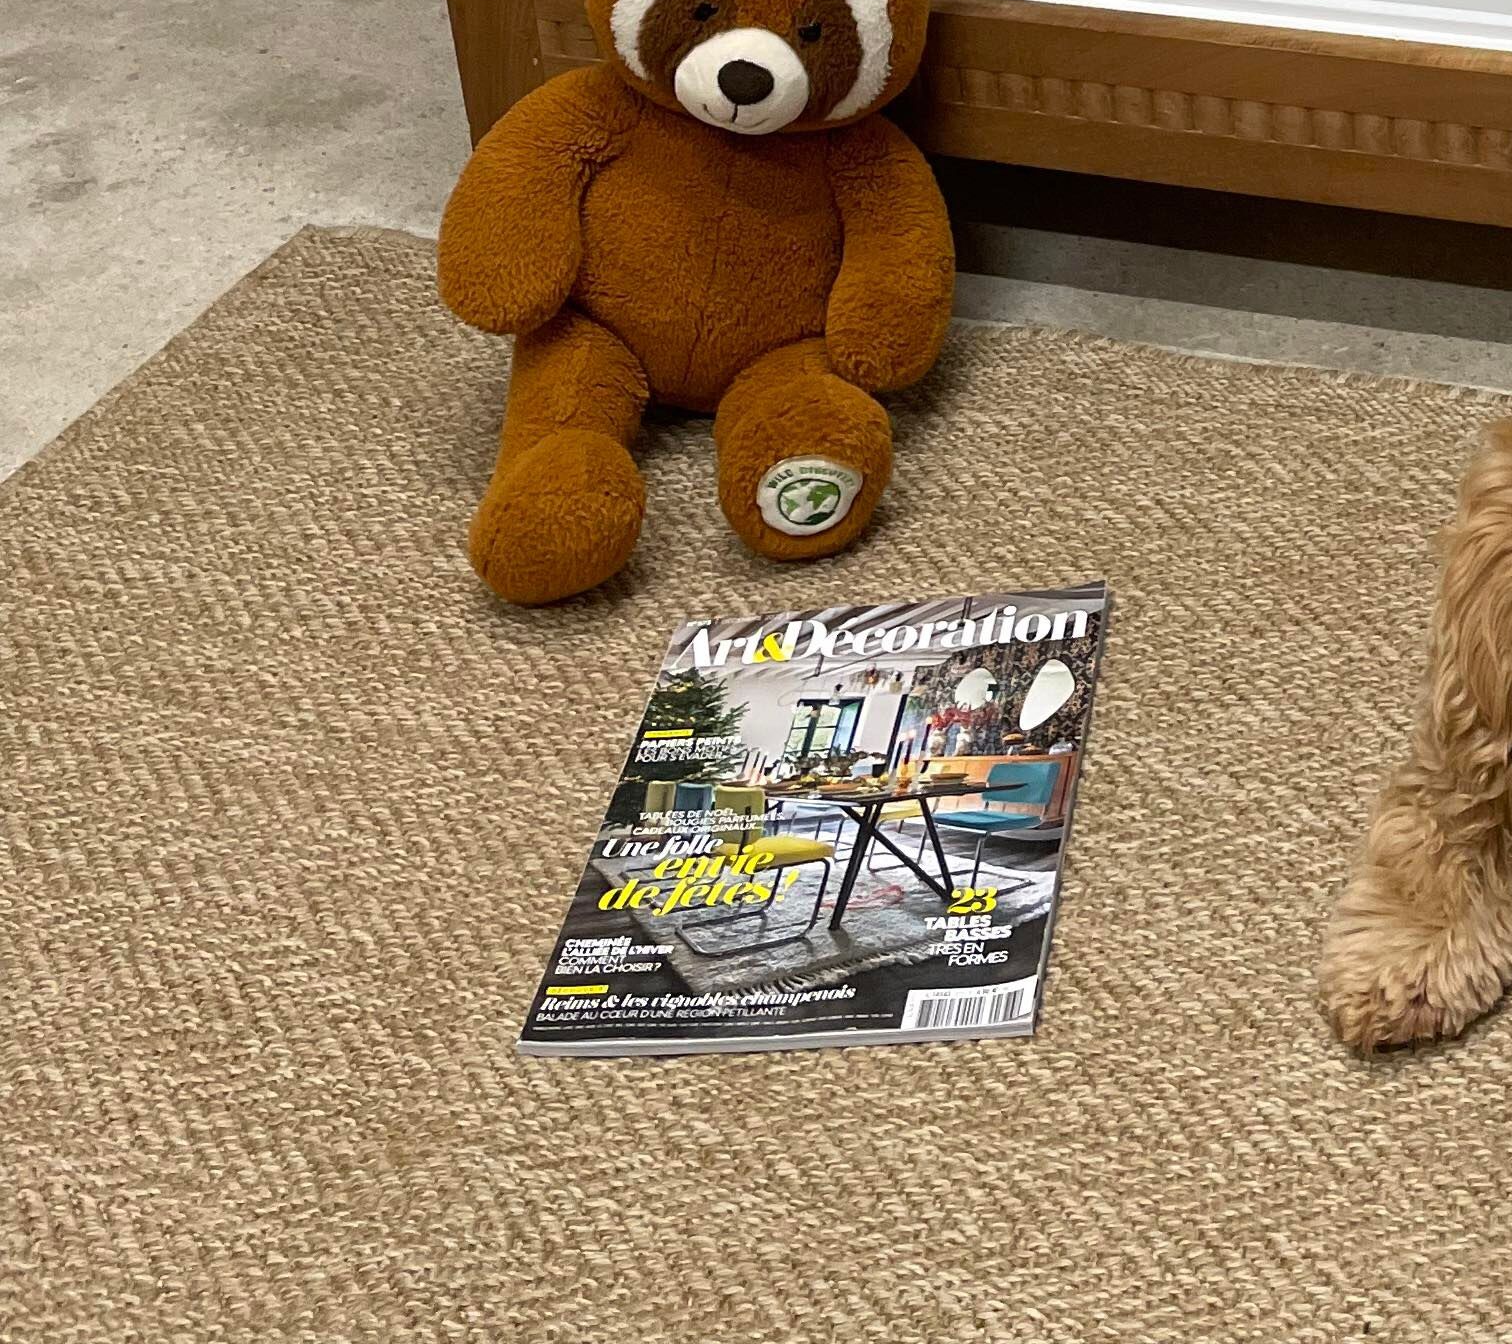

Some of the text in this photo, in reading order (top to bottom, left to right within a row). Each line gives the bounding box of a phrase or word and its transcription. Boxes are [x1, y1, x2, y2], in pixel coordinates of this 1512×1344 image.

[671, 605, 1088, 668] Art&Décoration
[687, 810, 703, 819] DE
[632, 825, 688, 836] CADEAUX
[602, 834, 724, 861] Une folle
[653, 845, 775, 880] envie
[598, 879, 661, 911] de
[947, 885, 998, 914] 23
[924, 914, 993, 930] TABLES
[943, 924, 1013, 942] BASSES
[610, 946, 629, 956] DE
[963, 941, 985, 954] EN
[558, 955, 627, 966] COMMENT
[948, 950, 1009, 966] FORMES
[585, 964, 601, 974] LA
[540, 984, 857, 1011] Reims & les vignobles champenois
[535, 1010, 580, 1022] BALADE
[580, 1010, 600, 1020] AU
